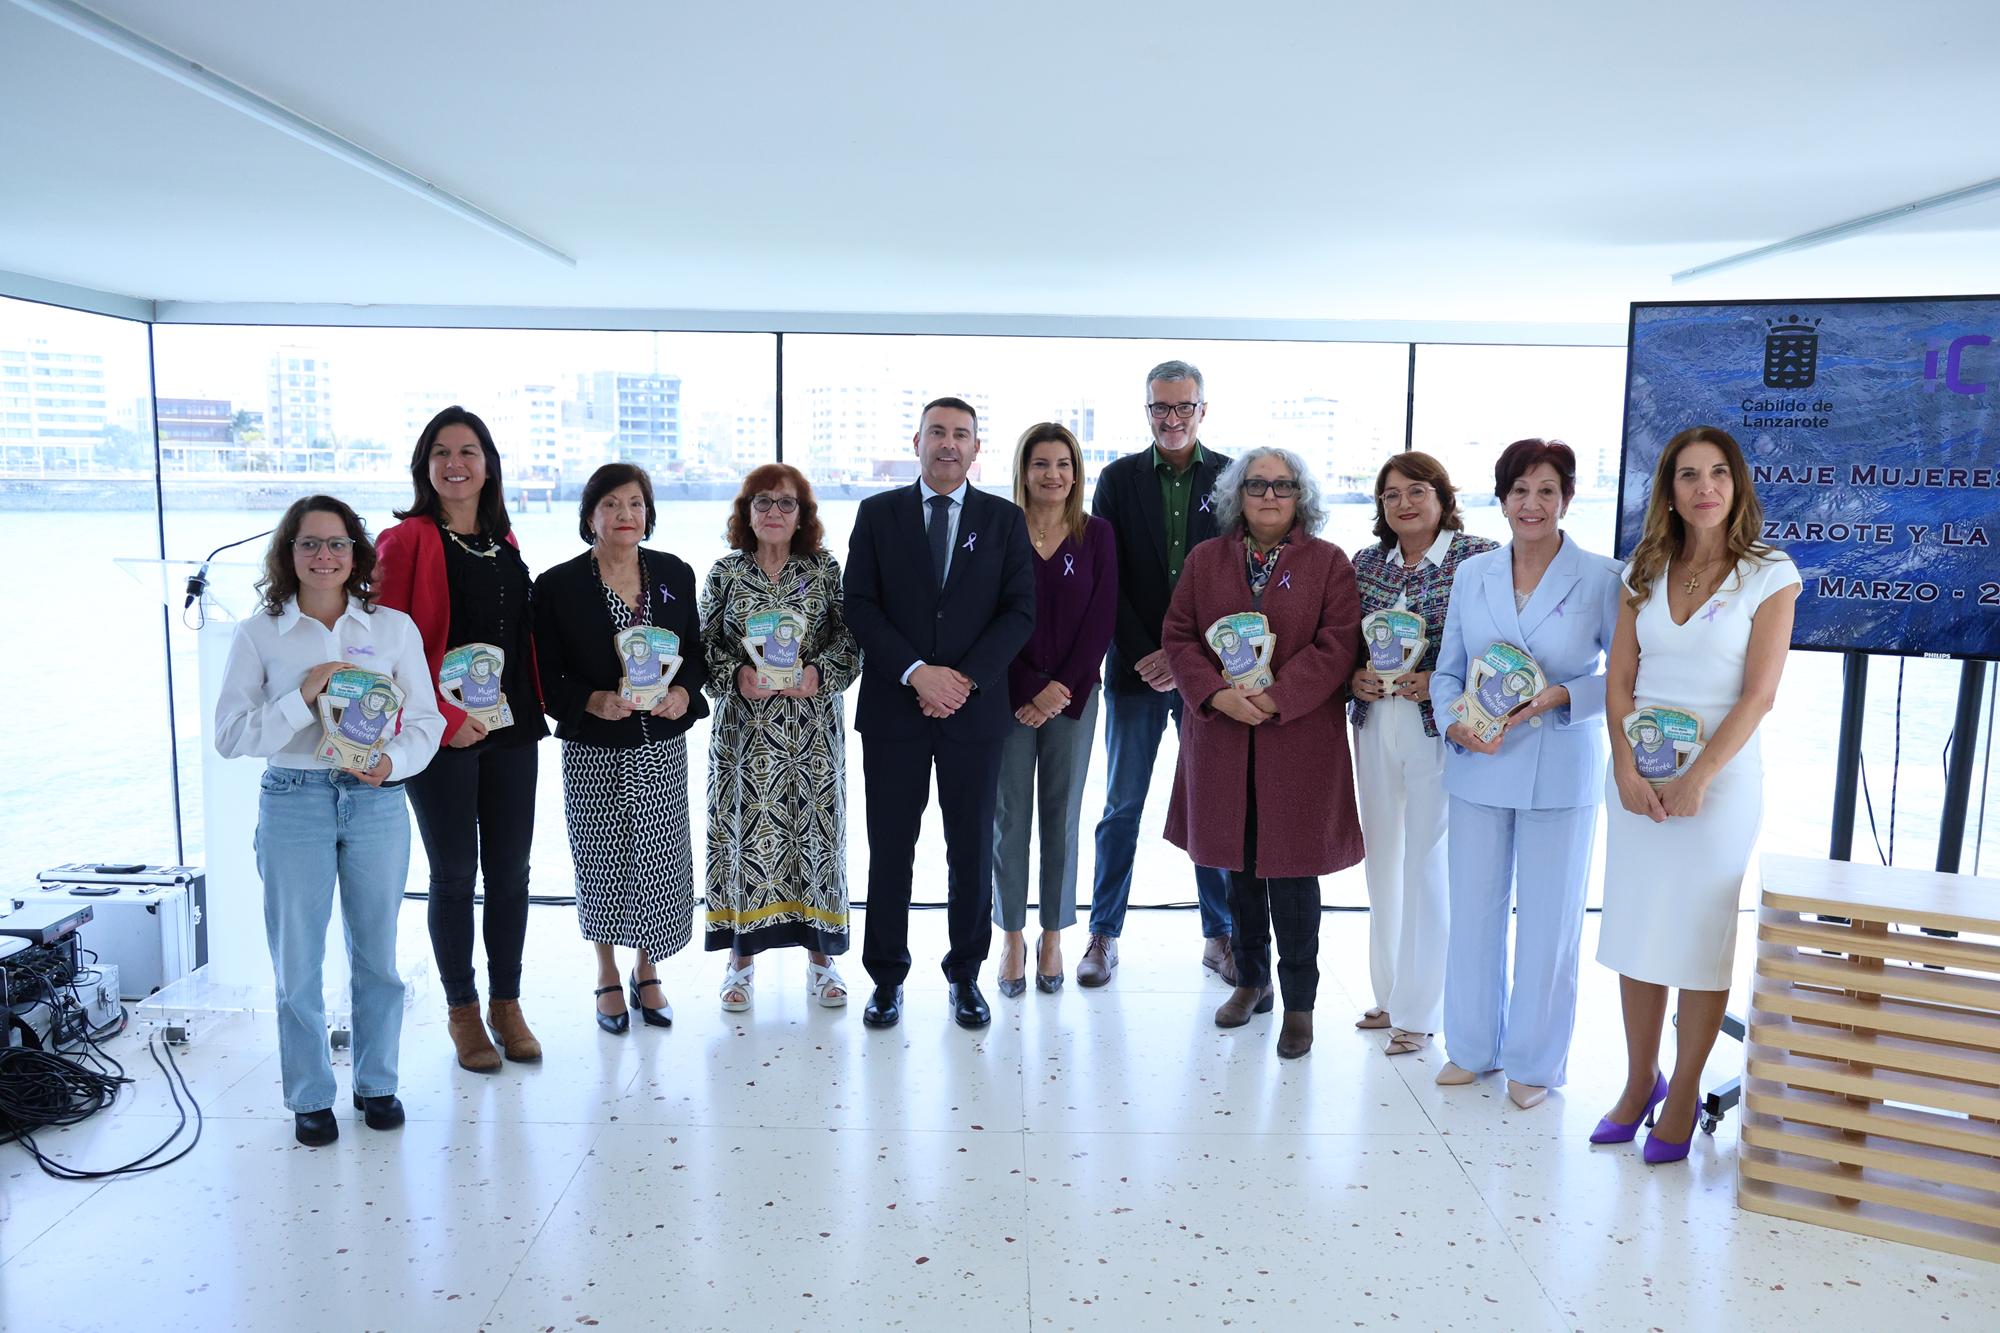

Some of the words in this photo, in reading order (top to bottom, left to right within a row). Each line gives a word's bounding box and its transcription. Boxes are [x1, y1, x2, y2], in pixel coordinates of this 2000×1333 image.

[1741, 399, 1806, 412] Cabildo
[1812, 399, 1833, 412] de
[1743, 415, 1829, 428] Lanzarote
[1753, 466, 1835, 485] NAJE
[1762, 521, 1894, 544] ZAROTE
[1941, 523, 1989, 546] LA
[1818, 576, 1939, 602] MARZO
[1978, 582, 2000, 606] 2
[767, 653, 794, 663] referente
[778, 649, 795, 657] Mujer
[1373, 652, 1389, 660] Mujer
[1923, 652, 1951, 660] PHILIPS
[1225, 656, 1242, 666] Mujer
[1228, 658, 1253, 672] referente
[1373, 657, 1399, 666] referente
[629, 667, 647, 676] Mujer
[630, 672, 658, 682] referente
[477, 687, 497, 696] Mujer
[467, 695, 498, 703] referente
[1480, 688, 1504, 714] referente
[1493, 692, 1509, 710] Mujer
[343, 721, 376, 740] referente
[358, 719, 380, 734] Mujer
[1638, 755, 1659, 766] Mujer
[1639, 762, 1673, 773] referente
